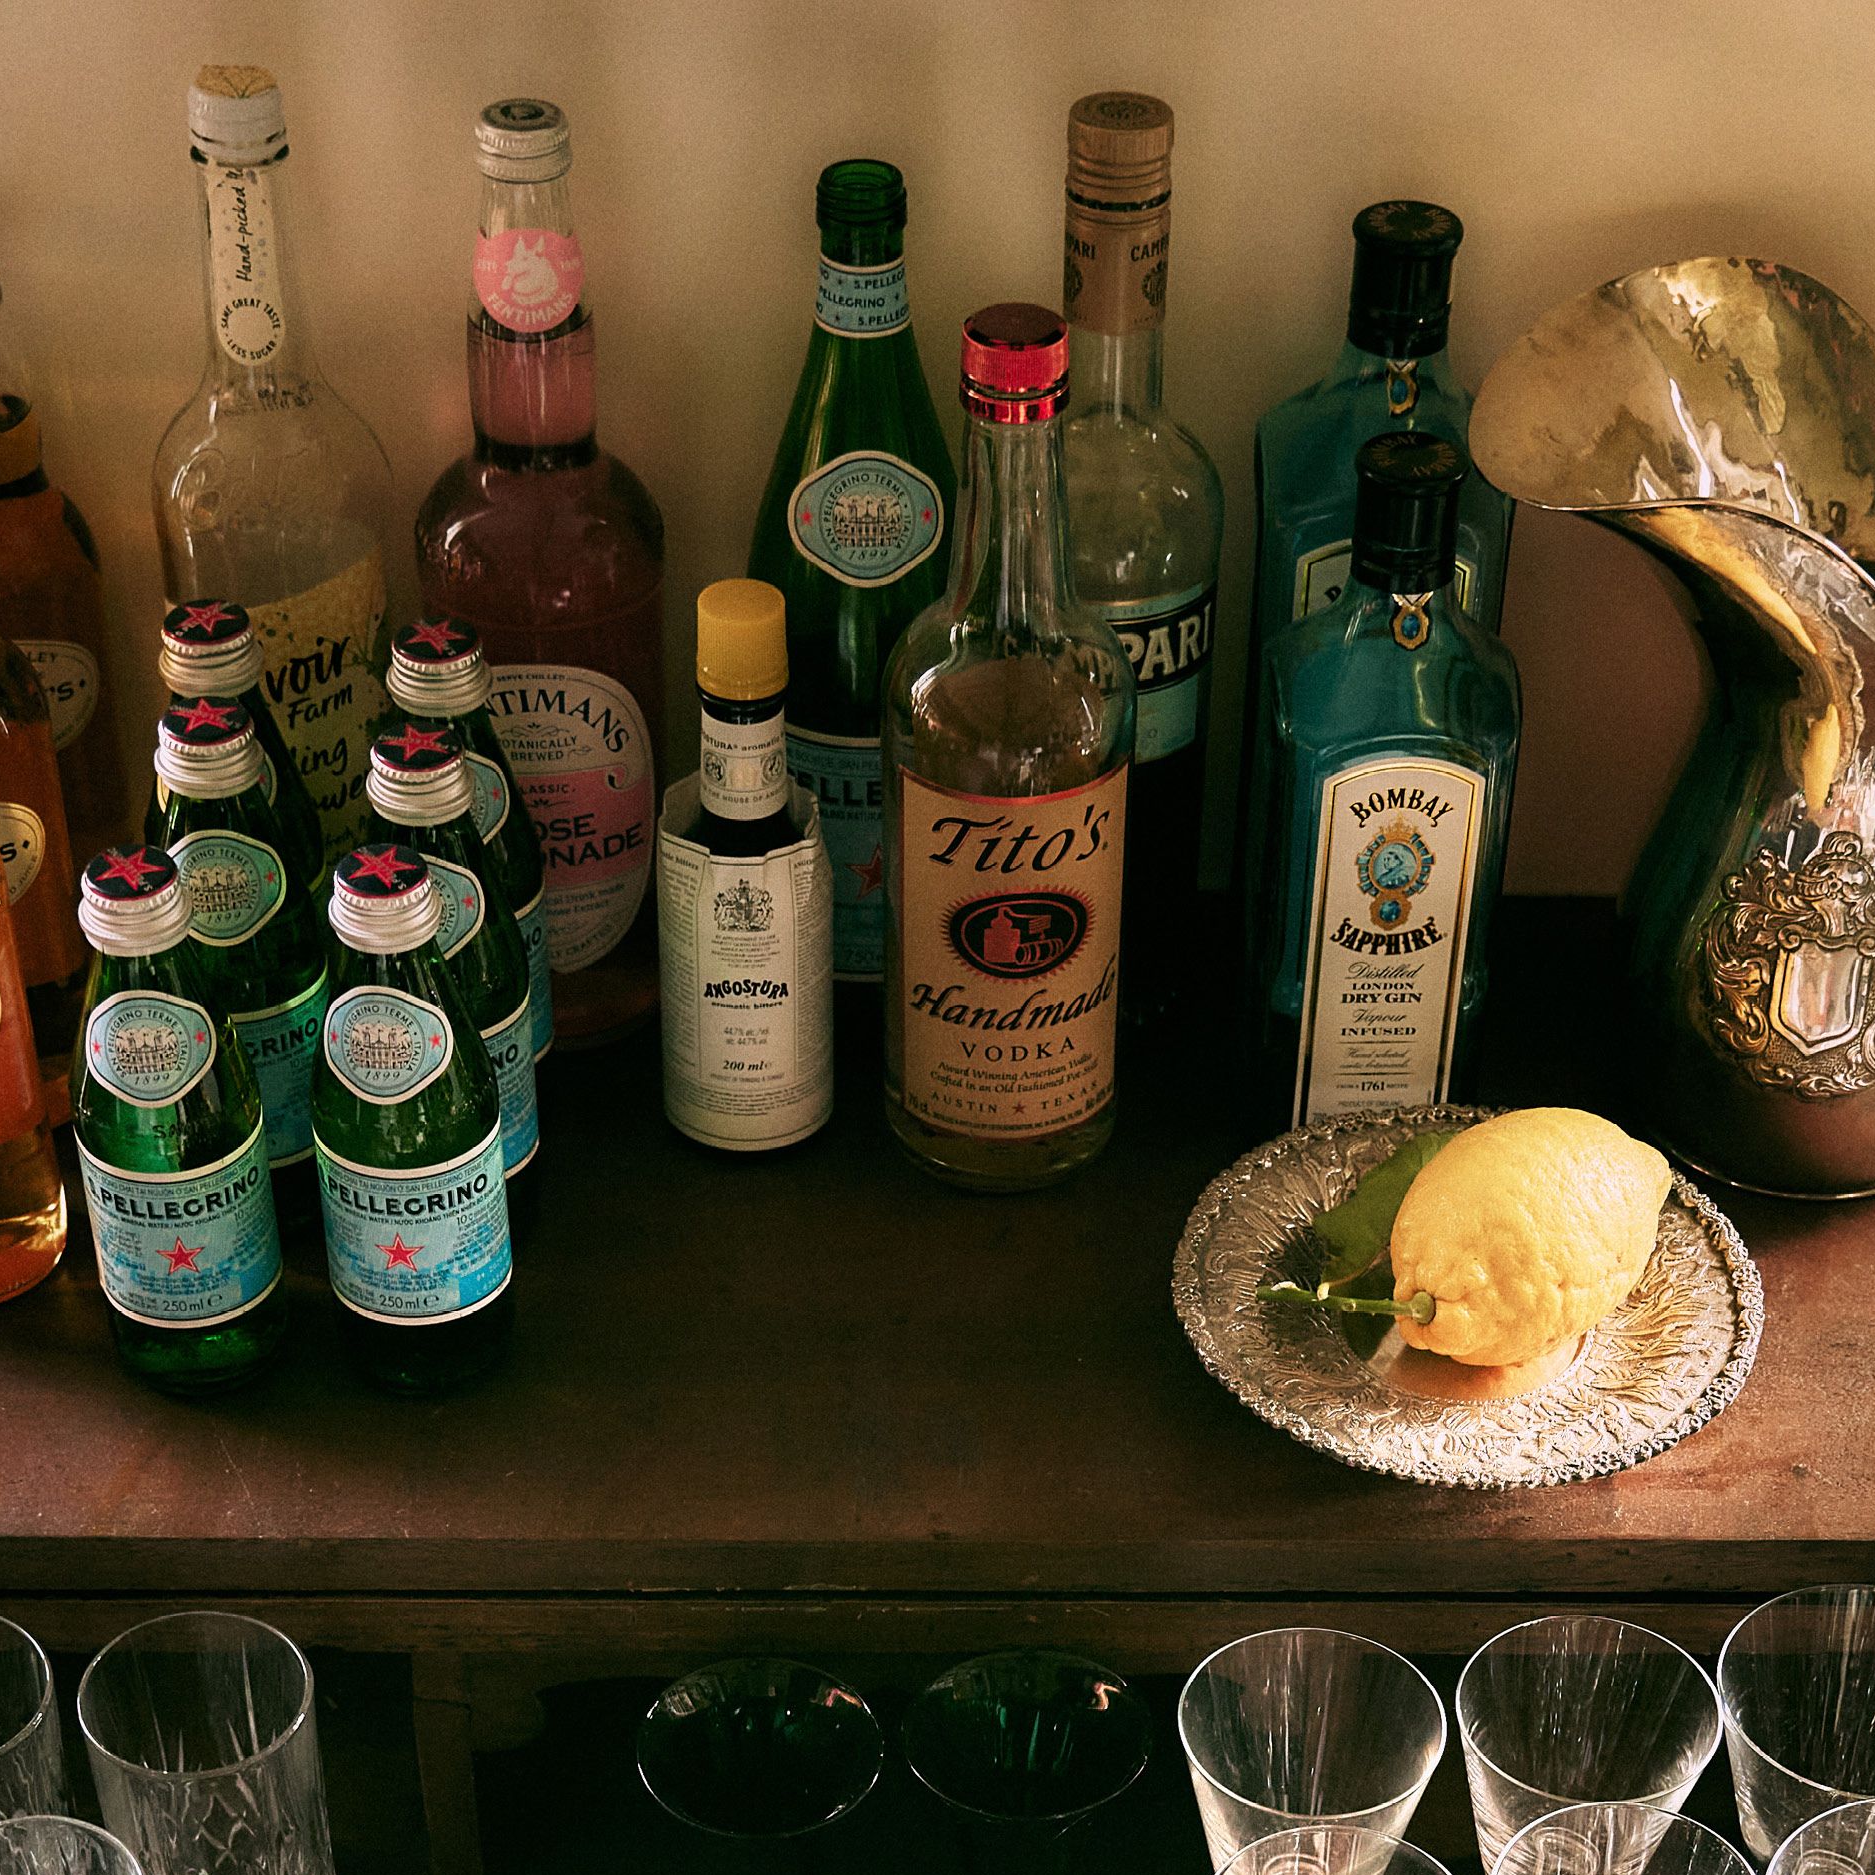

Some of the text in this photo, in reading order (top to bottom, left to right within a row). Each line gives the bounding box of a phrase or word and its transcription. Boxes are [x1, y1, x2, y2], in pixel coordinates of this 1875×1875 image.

[231, 185, 254, 283] Hand-picked
[220, 297, 282, 330] SAME GREAT TASTE
[487, 290, 574, 325] FENTIMANS
[226, 338, 278, 361] LESS SUGAR
[823, 473, 911, 552] SAN PELLEGRINO TERME ITALIA
[1118, 601, 1213, 682] PARI
[264, 635, 352, 705] voir
[495, 673, 566, 682] SERVE CHILLED
[286, 682, 353, 730] Farm
[484, 688, 630, 753] NTIMANS
[502, 735, 578, 750] OTANICALLY
[510, 749, 565, 762] BREWED
[523, 783, 572, 795] LASSIC
[722, 794, 750, 804] HOUSE
[752, 794, 764, 804] OF
[1348, 787, 1455, 829] BOMBAY
[534, 812, 598, 842] OSE
[548, 820, 646, 870] NADE
[928, 804, 1110, 874] Tito's
[442, 903, 456, 934] ITALIA
[1330, 915, 1443, 956] SAPPHIRE
[1343, 961, 1425, 980] Distilled
[703, 978, 789, 1000] ANGOSTURA
[911, 952, 1118, 1032] Handmade
[1352, 982, 1416, 991] LONDON
[711, 1001, 783, 1010] aromatic bitters
[1339, 992, 1423, 1005] DRY GIN
[1352, 1007, 1408, 1026] Vapour
[108, 1009, 144, 1054] PELLEGRINO
[147, 1009, 179, 1028] TERME
[174, 1039, 189, 1072] ITALIA
[343, 1004, 380, 1045] PELLEGRINO
[384, 1006, 415, 1029] TERME
[405, 1041, 422, 1072] ITALIA
[1339, 1026, 1417, 1037] INFUSED
[959, 1036, 1076, 1063] VODKA
[1347, 1046, 1373, 1059] Hand
[364, 1070, 401, 1081] 1899
[723, 1060, 765, 1072] 200 ml
[938, 1052, 1094, 1083] Award Winning American Vodka
[133, 1072, 170, 1085] 1899
[930, 1070, 963, 1087] Crafted
[965, 1079, 977, 1091] in
[978, 1083, 992, 1092] an
[994, 1081, 1015, 1093] Old
[1017, 1075, 1065, 1093] Fashioned
[1066, 1070, 1081, 1083] Pot
[1360, 1080, 1386, 1091] 1761
[931, 1091, 998, 1114] AUSTIN
[1041, 1079, 1098, 1110] TEXAS
[404, 1184, 421, 1193] SAN
[421, 1173, 463, 1191] PELLEGRINO
[368, 1216, 389, 1225] WATER
[456, 1214, 467, 1226] 10
[163, 1299, 205, 1312] 250 ml
[379, 1293, 420, 1310] 250 ml
